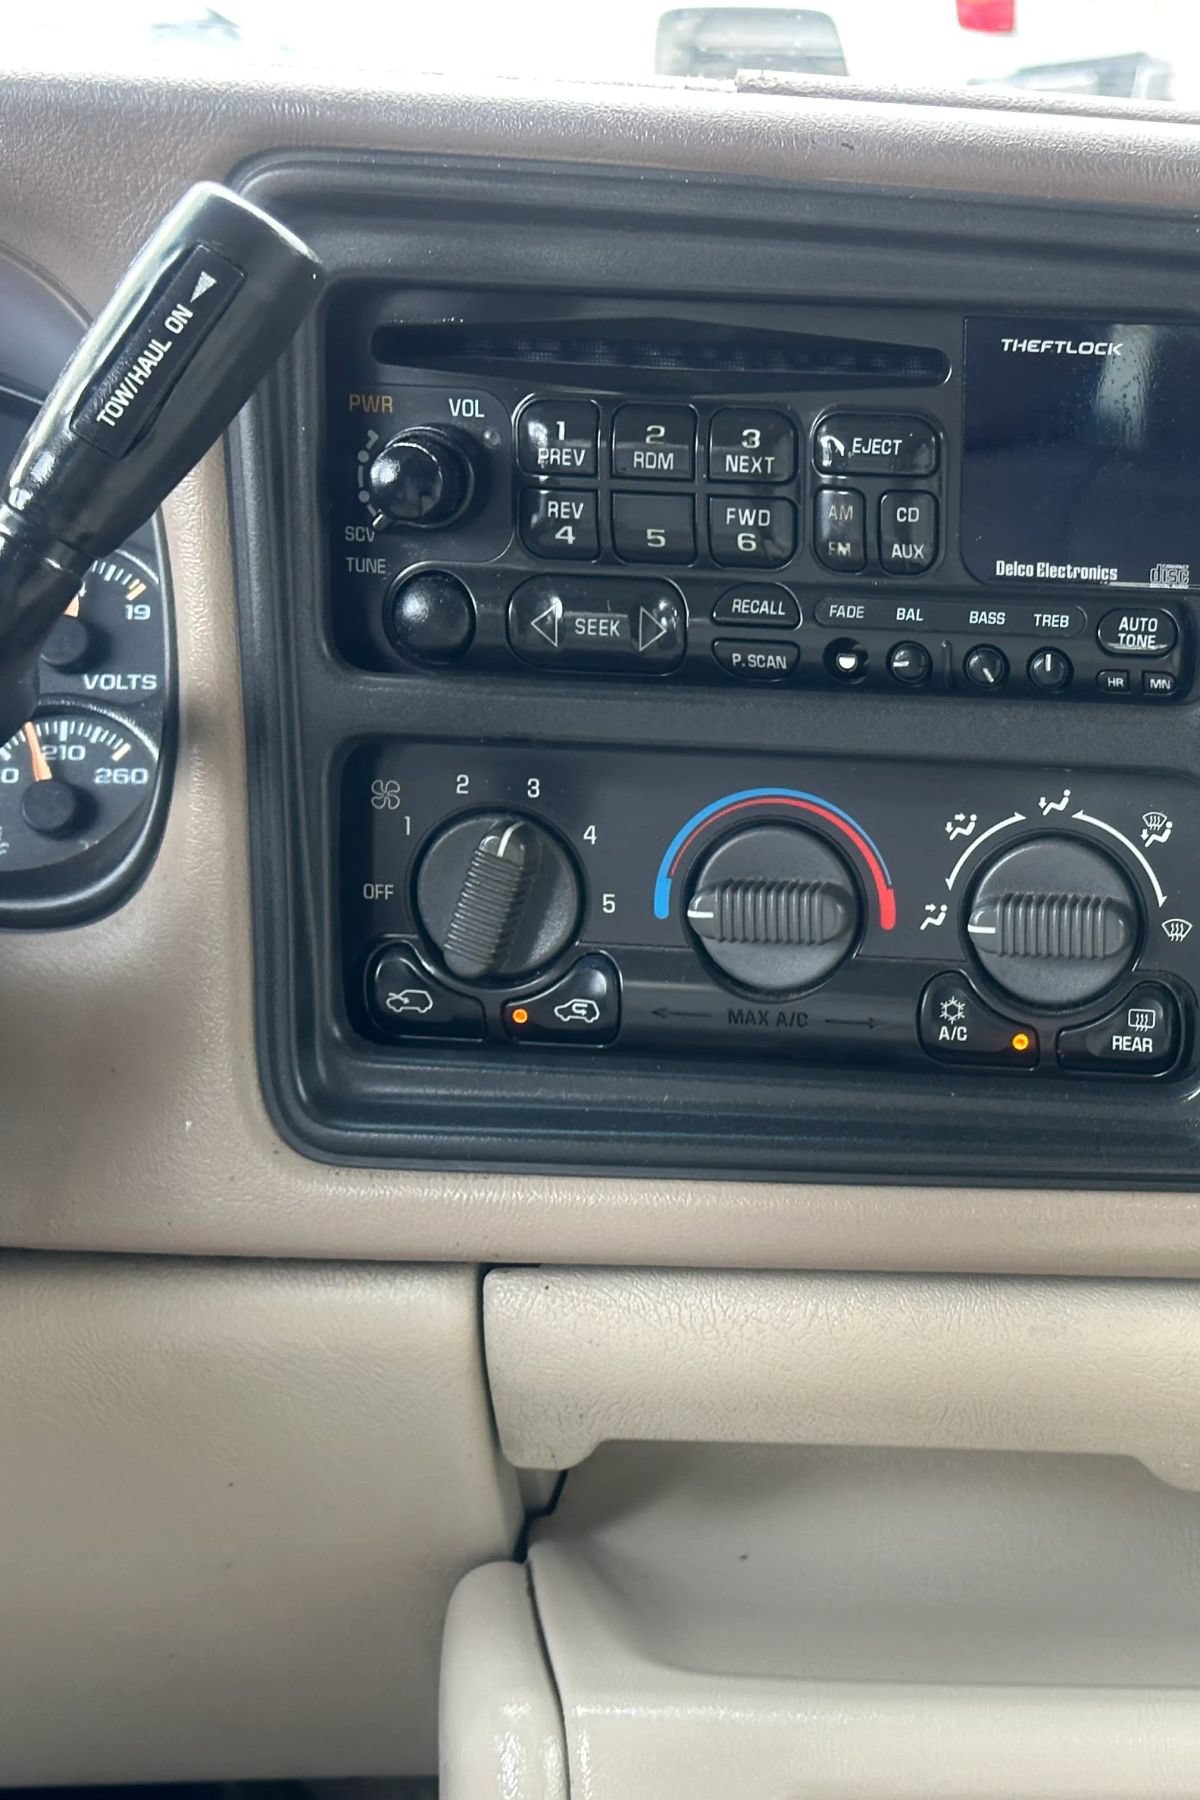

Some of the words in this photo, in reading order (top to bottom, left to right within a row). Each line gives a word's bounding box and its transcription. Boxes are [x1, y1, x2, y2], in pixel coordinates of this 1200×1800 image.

[1001, 338, 1124, 356] THEFTLOCK
[96, 338, 172, 427] TOW/HAUL
[164, 303, 194, 334] ON
[349, 394, 393, 414] PWR
[449, 398, 485, 418] VOL
[556, 421, 566, 441] 1
[645, 425, 665, 444] 2
[741, 429, 761, 449] 3
[852, 437, 902, 455] EJECT
[537, 448, 586, 467] PREV
[633, 451, 674, 470] RDM
[725, 454, 775, 474] NEXT
[547, 501, 584, 519] REV
[726, 507, 770, 527] FWD
[828, 505, 853, 521] AM
[896, 506, 920, 522] CD
[344, 525, 375, 542] SCV
[554, 526, 576, 545] 4
[646, 529, 666, 548] 5
[737, 533, 757, 552] 6
[828, 541, 851, 557] FM
[891, 543, 924, 558] AUX
[346, 557, 386, 574] TUNE
[996, 560, 1034, 578] Delco
[1036, 562, 1118, 581] Electronics
[125, 604, 151, 620] 19
[731, 599, 786, 615] RECALL
[829, 605, 865, 619] FADE
[896, 607, 923, 621] BAL
[969, 611, 1006, 625] BASS
[1034, 613, 1069, 628] TREB
[1118, 616, 1158, 632] AUTO
[575, 618, 621, 637] SEEK
[1118, 633, 1156, 649] TONE
[732, 653, 787, 670] P.SCAN
[83, 674, 157, 690] VOLTS
[1107, 677, 1124, 687] HR
[1150, 679, 1171, 689] MN
[42, 744, 86, 761] 210
[94, 767, 149, 784] 260
[456, 774, 469, 794] 2
[527, 778, 540, 798] 3
[404, 815, 411, 836] 1
[583, 825, 598, 844] 4
[363, 884, 394, 900] OFF
[602, 894, 616, 913] 5
[728, 1008, 769, 1025] MAX
[776, 1011, 808, 1028] A/C
[938, 1025, 968, 1042] A/C
[1111, 1035, 1153, 1053] REAR
